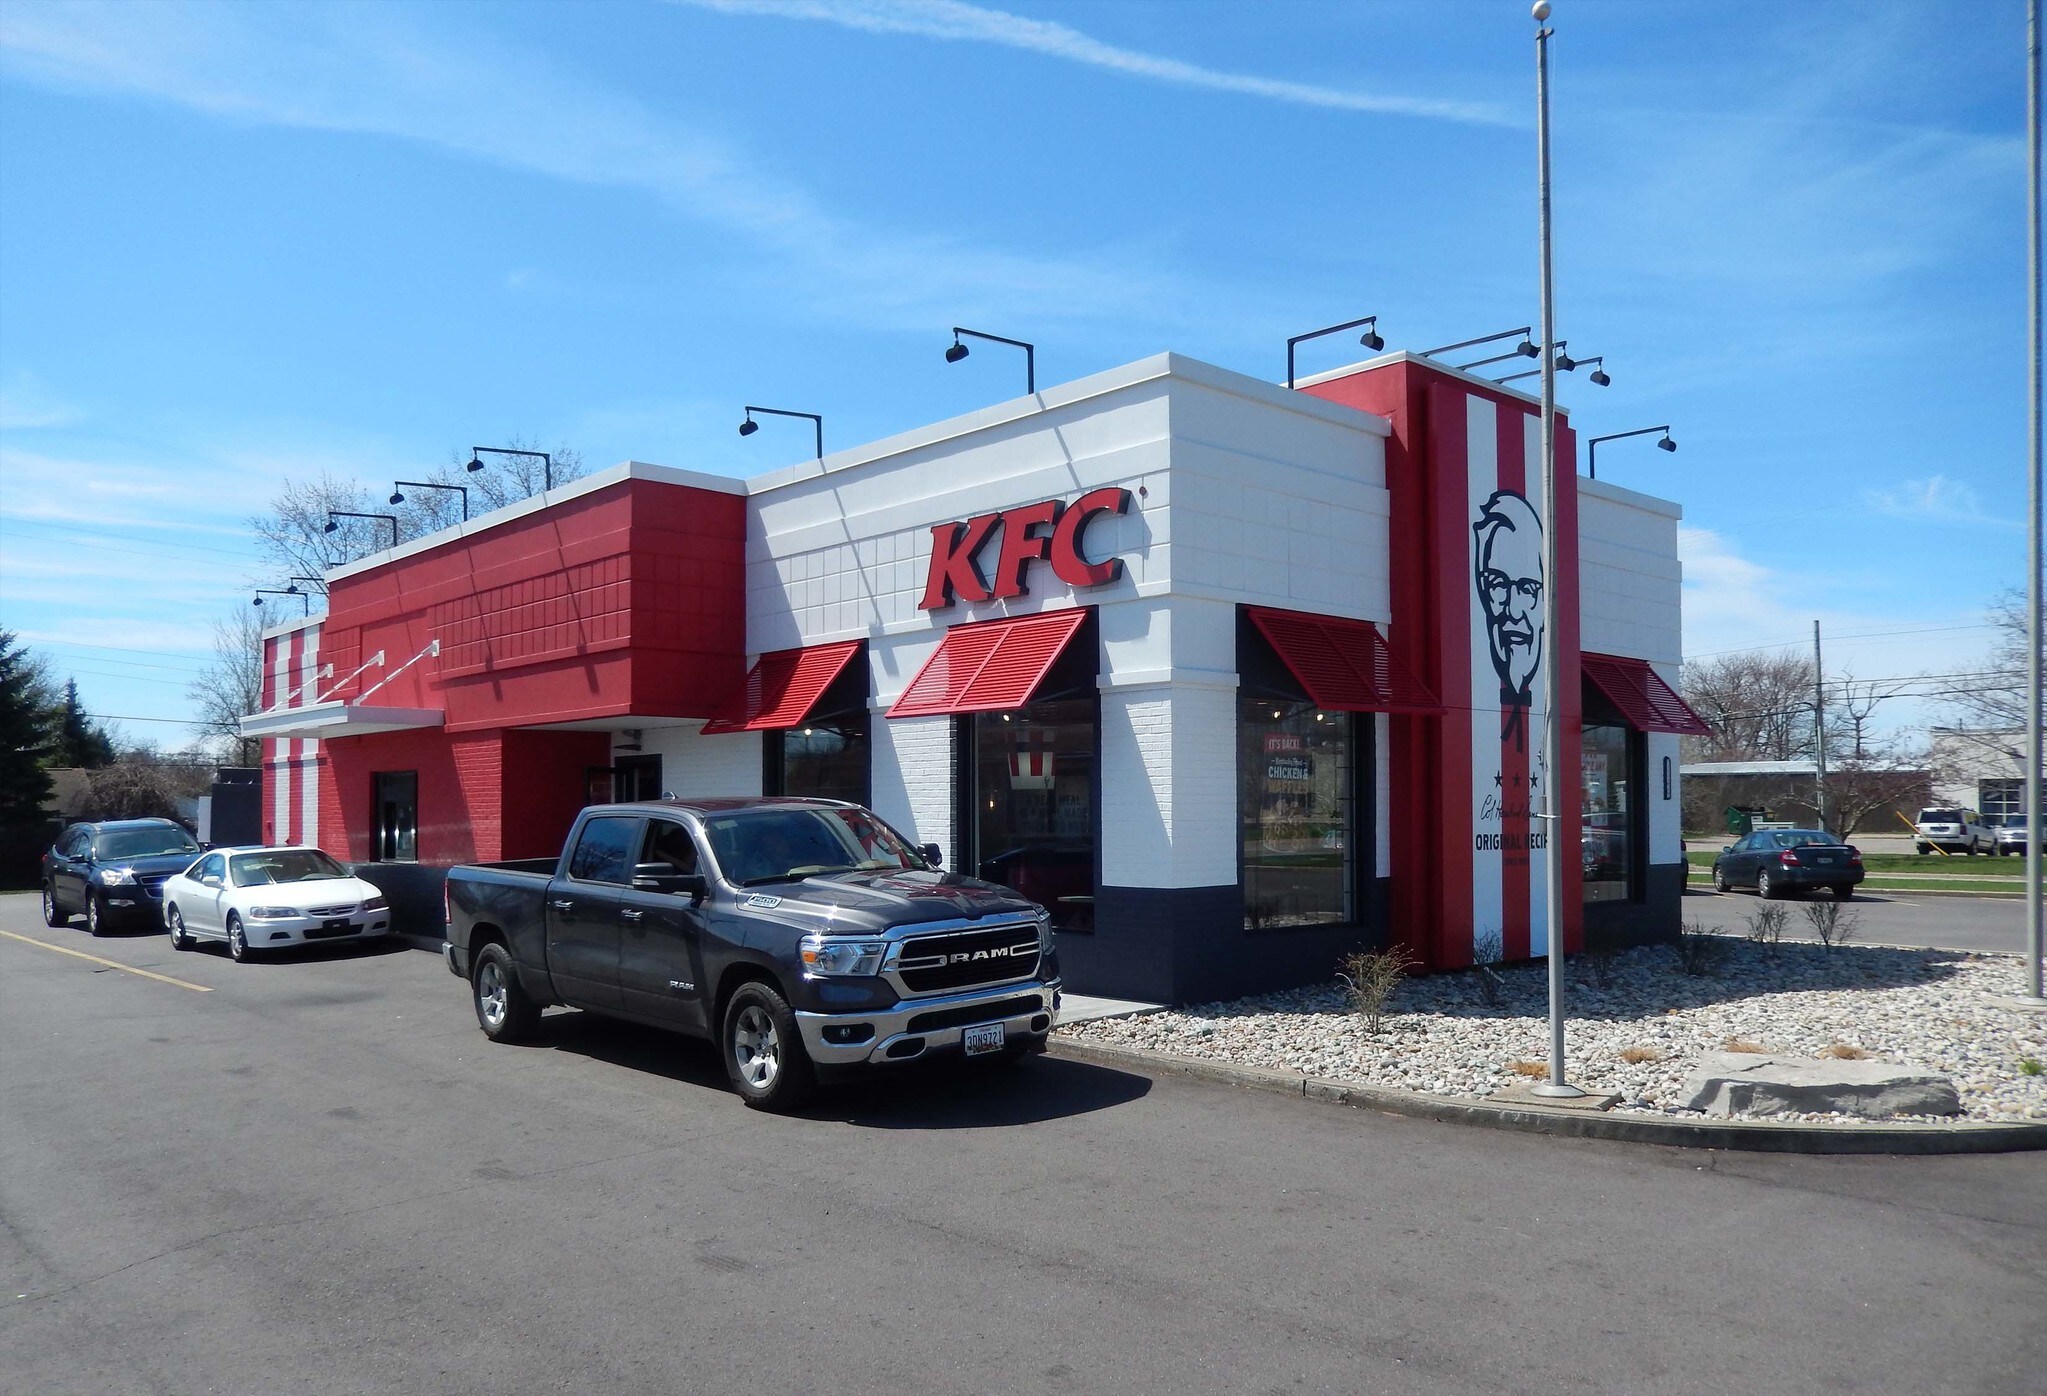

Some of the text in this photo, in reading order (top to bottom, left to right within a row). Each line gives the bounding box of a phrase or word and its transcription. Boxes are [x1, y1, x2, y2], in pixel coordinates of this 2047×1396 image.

[918, 487, 1132, 610] KFC
[1475, 833, 1548, 851] ORIGINAL RECIP
[950, 947, 1008, 964] RAM
